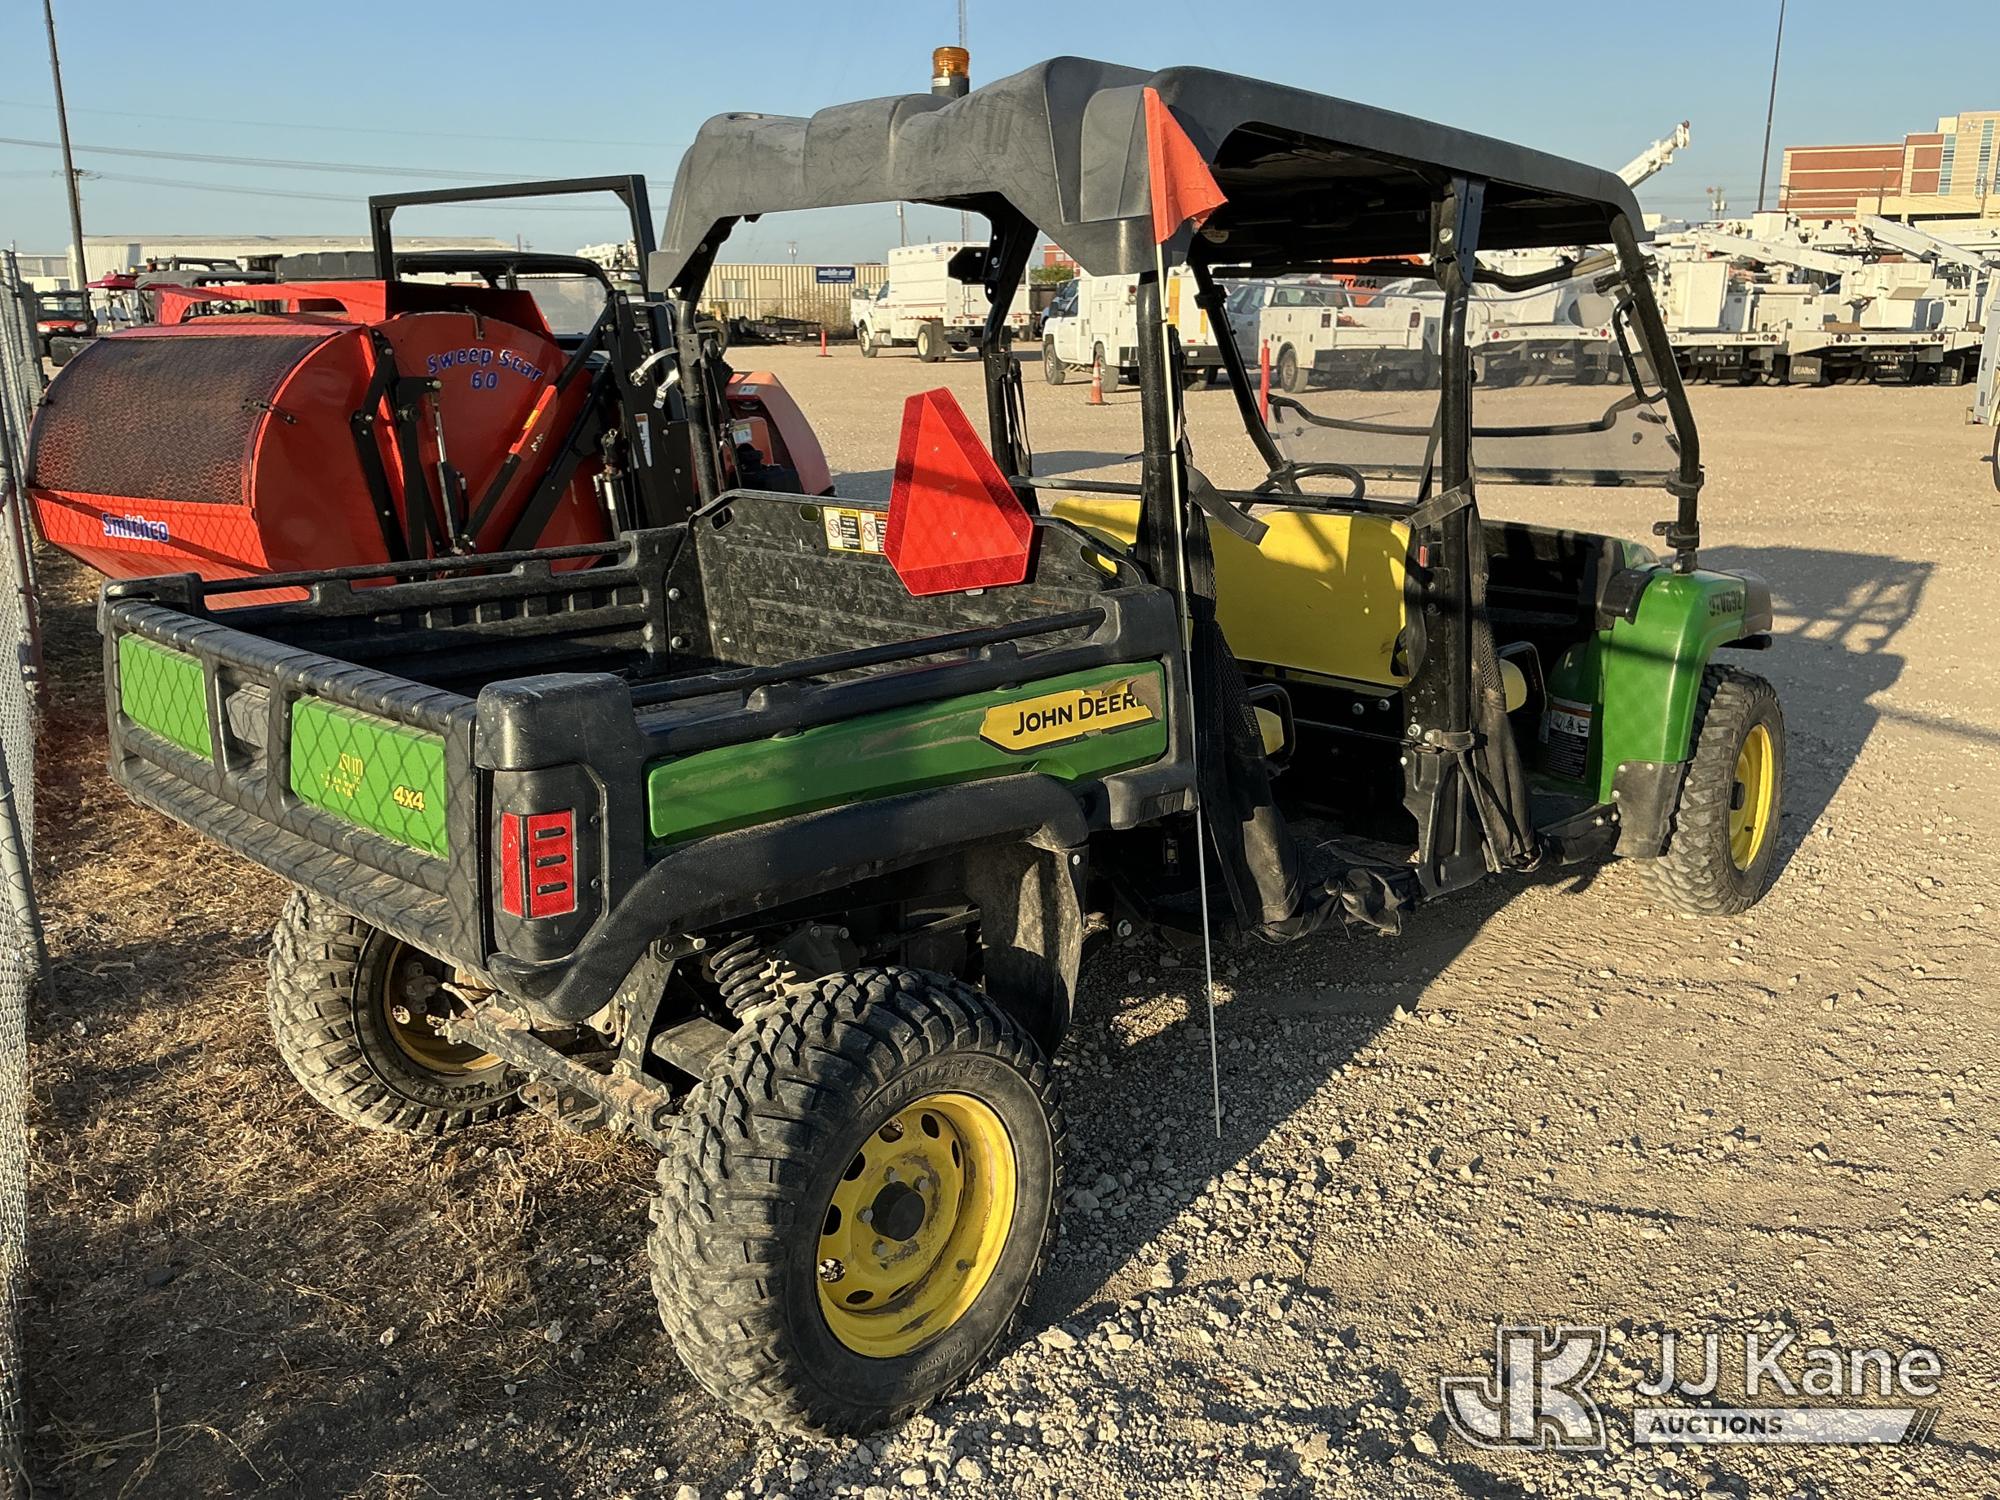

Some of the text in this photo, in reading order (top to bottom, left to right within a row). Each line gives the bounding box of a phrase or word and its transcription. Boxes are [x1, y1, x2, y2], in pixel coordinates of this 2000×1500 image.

[427, 347, 544, 382] Sweep Star
[471, 370, 498, 390] 60
[102, 513, 169, 542] Smithco
[1013, 692, 1138, 736] JOHN DEER
